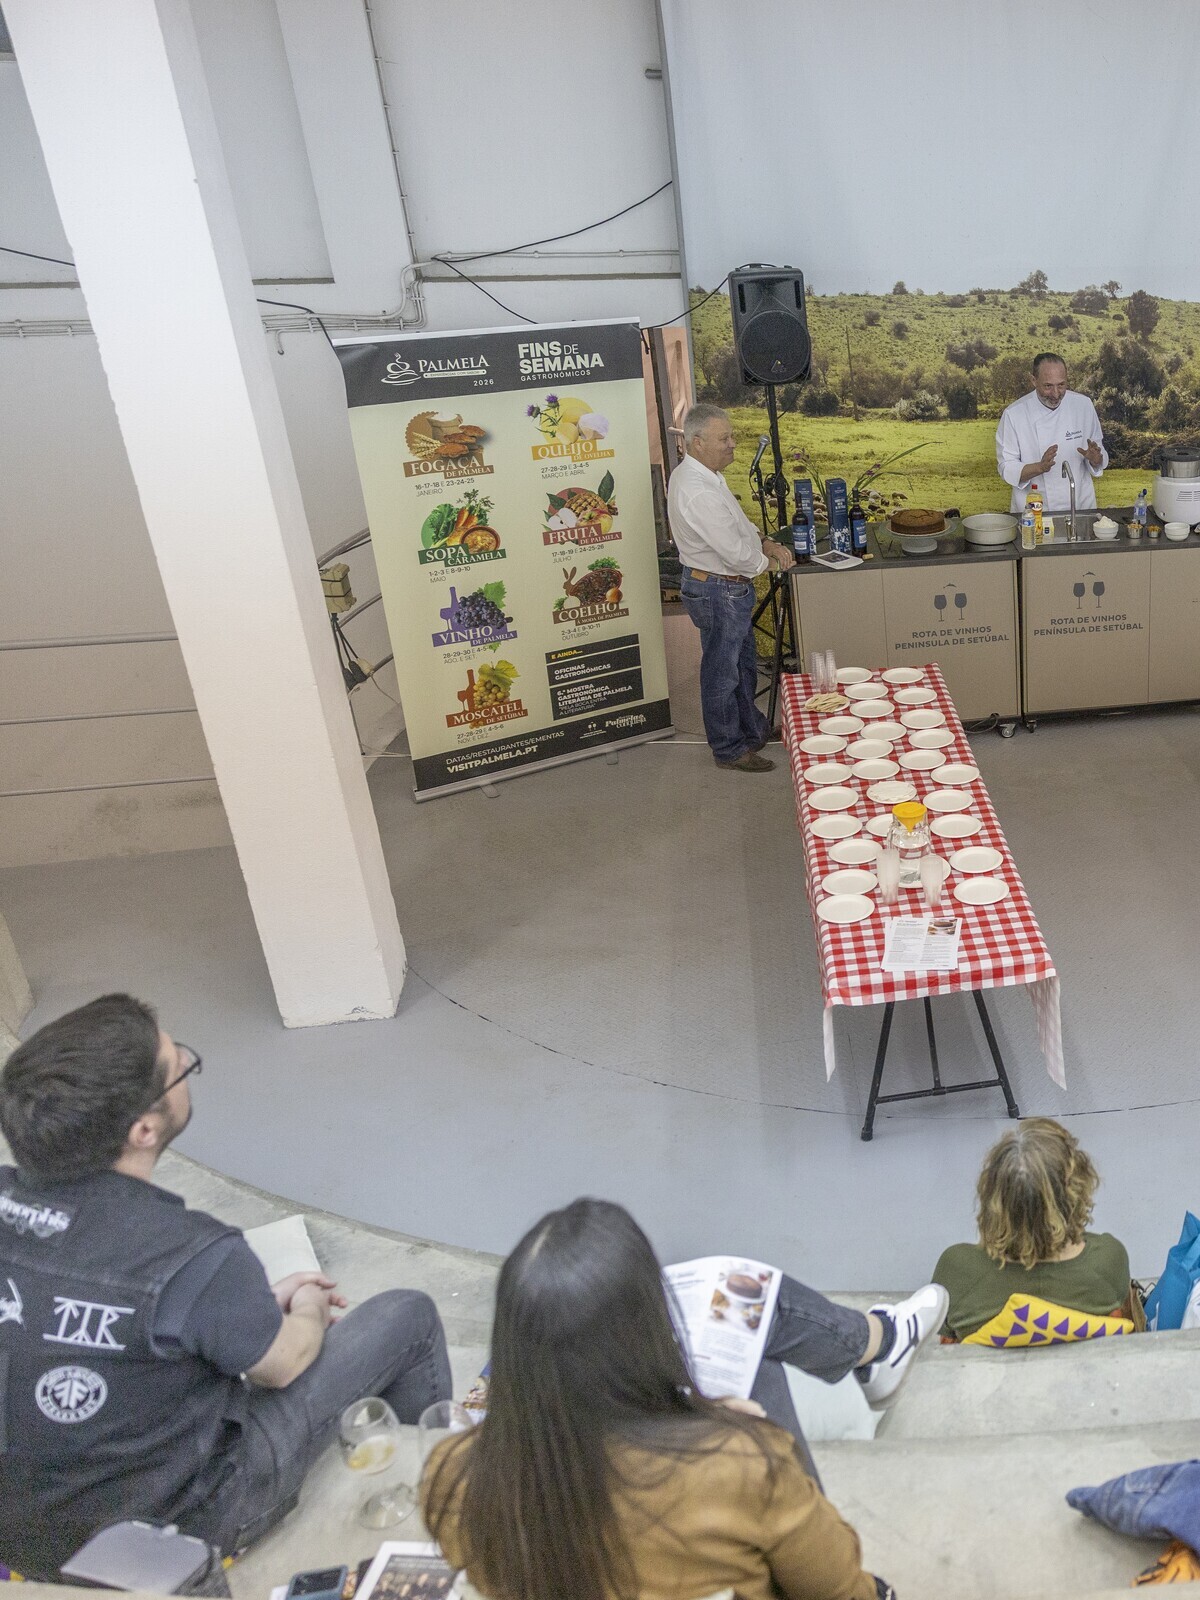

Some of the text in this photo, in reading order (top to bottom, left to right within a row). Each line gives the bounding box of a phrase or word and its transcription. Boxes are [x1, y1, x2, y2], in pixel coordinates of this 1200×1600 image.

[518, 341, 579, 358] FINS DE
[418, 355, 490, 372] PALMELA
[519, 353, 604, 374] SEMANA
[521, 370, 591, 381] GASTRONÓMICOS
[538, 442, 593, 459] QUEIJO
[584, 451, 611, 459] OVELHA
[411, 456, 481, 475] FOGAÇA
[459, 467, 491, 476] PALMELA
[541, 465, 567, 473] 27-28-29
[415, 482, 440, 490] 16-17-18
[446, 478, 475, 486] 23-24-25
[416, 488, 443, 497] JANEIRO
[549, 526, 598, 543] FRUTA
[591, 534, 620, 543] PALMELA
[426, 546, 468, 562] SOPA
[552, 549, 573, 557] 17-18-19
[580, 544, 604, 552] 24-25-26
[448, 551, 502, 566] CARAMELA
[559, 603, 617, 622] COELHO
[1092, 614, 1127, 622] VINHOS
[440, 626, 493, 644] VINHO
[562, 631, 589, 640] OUTUBRO
[912, 630, 937, 639] ROTA
[954, 626, 992, 635] VINHOS
[1034, 625, 1086, 636] PENÍNSULA
[1103, 622, 1143, 631] SETÚBAL
[484, 633, 514, 643] PALMELA
[968, 634, 1009, 644] SETÚBAL
[443, 650, 471, 659] 28-29-30
[554, 664, 586, 674] OFICINAS
[555, 664, 611, 680] GASTRONÓMICAS
[558, 685, 610, 701] GASTRONÓMICA
[567, 684, 594, 693] MOSTRA
[559, 695, 592, 707] LITERÁRIA
[603, 685, 632, 696] PALMELA
[454, 702, 520, 724] MOSCATEL
[497, 711, 526, 722] SETÚBAL
[457, 729, 482, 739] 27-28-29
[446, 731, 565, 765] DATAS/RESTAURANTES/EMENTAS
[447, 745, 538, 773] VISITPALMELA.PT
